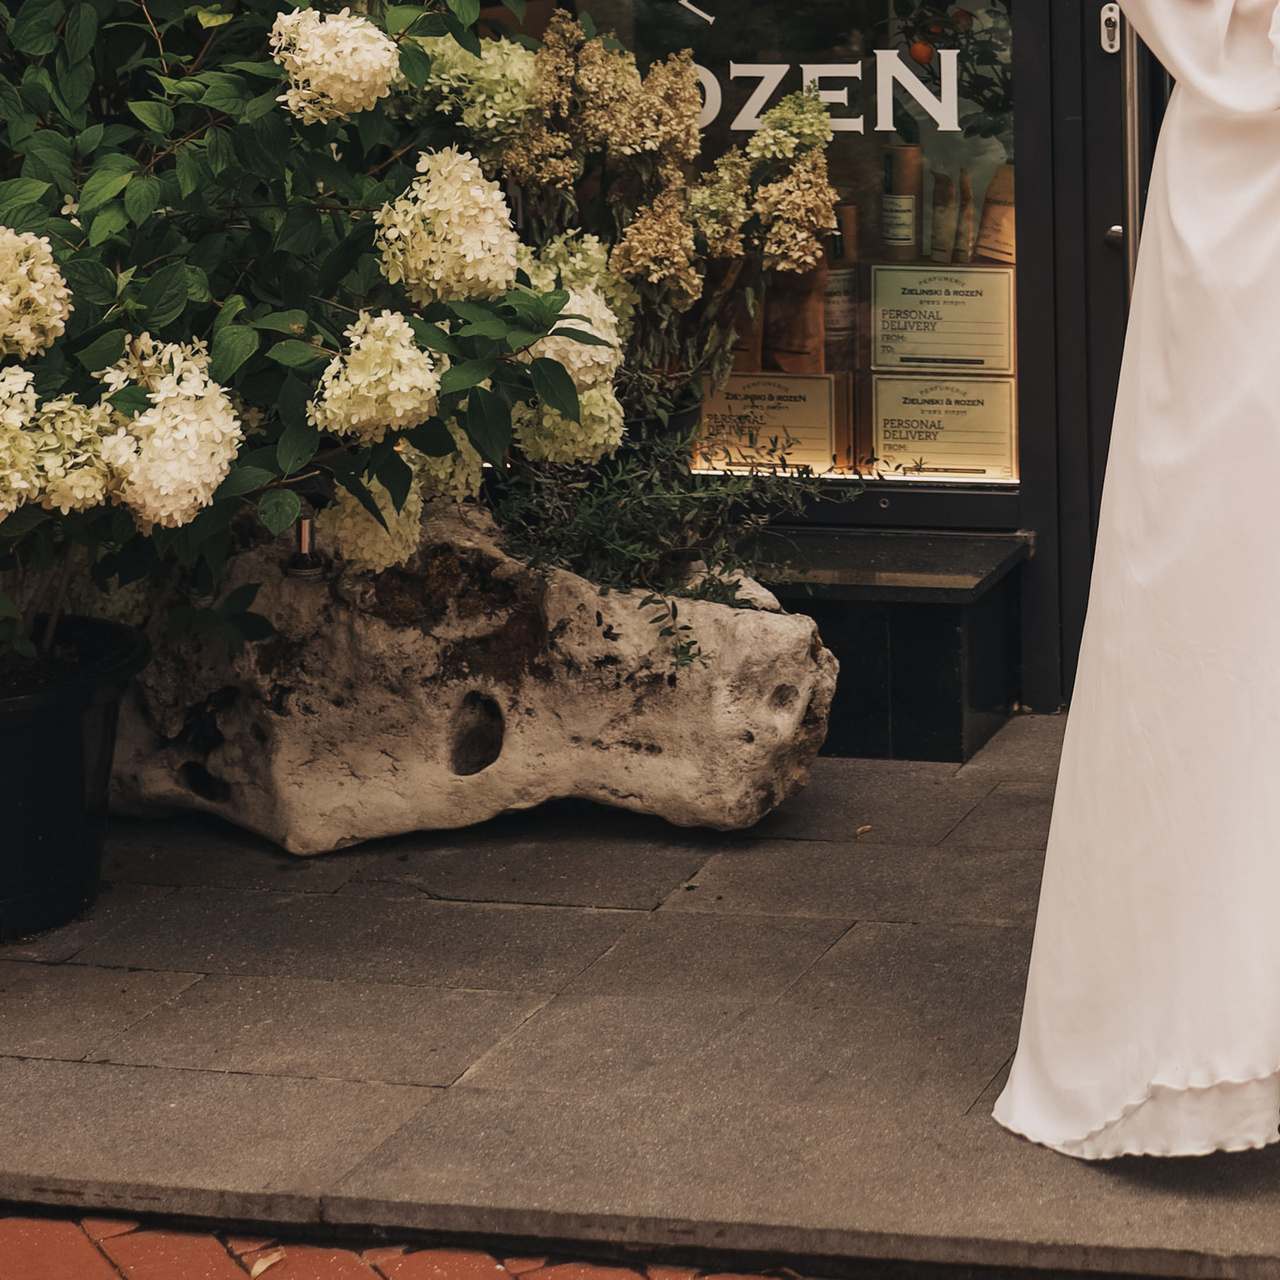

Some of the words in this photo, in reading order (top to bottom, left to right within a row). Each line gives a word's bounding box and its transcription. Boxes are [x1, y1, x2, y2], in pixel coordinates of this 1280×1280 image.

[901, 287, 942, 296] ZIELINSKI
[881, 309, 943, 321] PERSONAL
[881, 320, 938, 332] DELIVERY
[776, 394, 807, 402] ROZEN
[902, 396, 943, 405] ZIELINSKI
[954, 399, 984, 407] ROZEN
[883, 418, 944, 430] PERSONAL
[883, 429, 939, 441] DELIVERY
